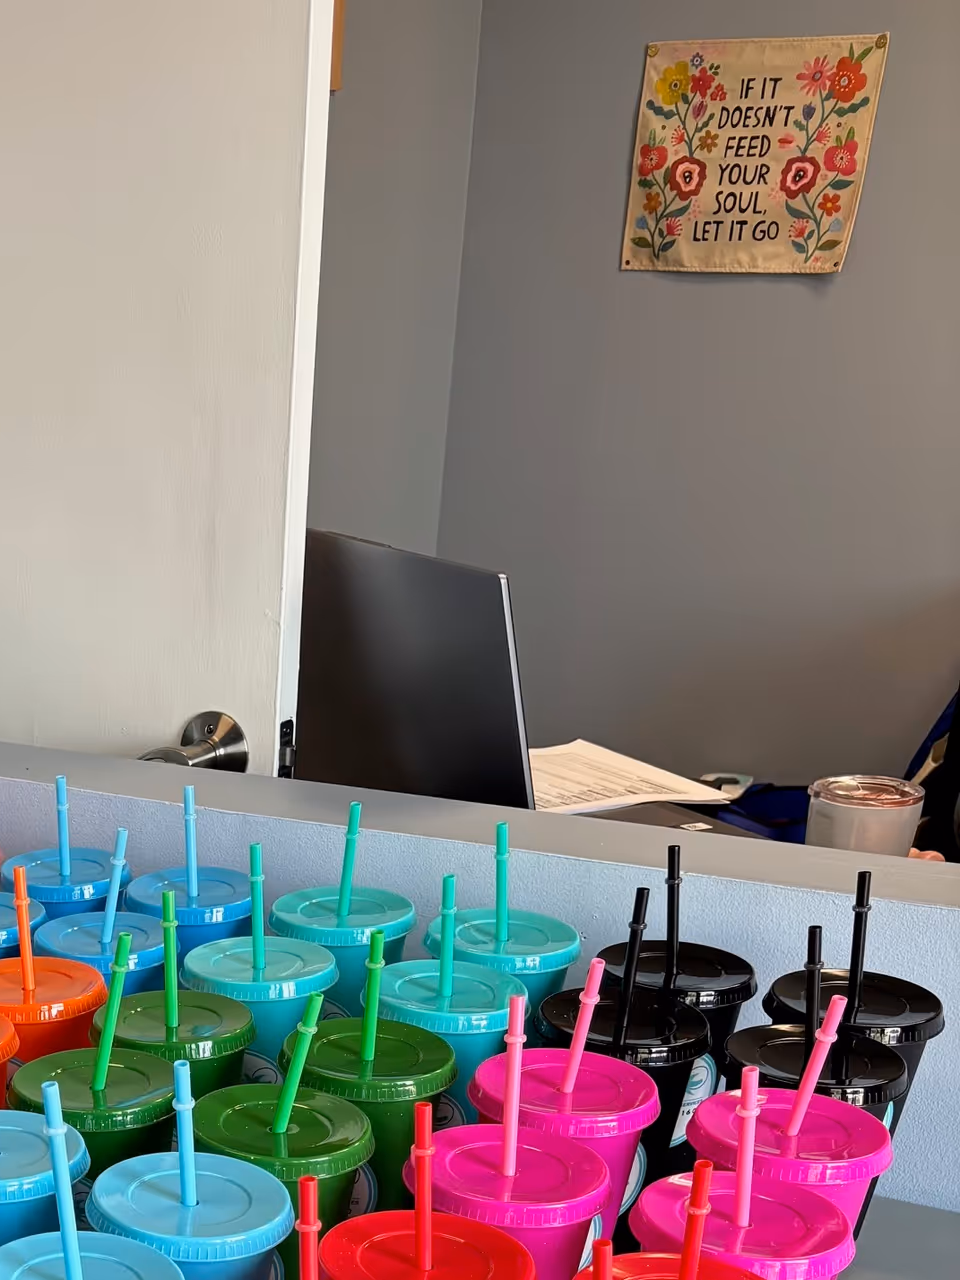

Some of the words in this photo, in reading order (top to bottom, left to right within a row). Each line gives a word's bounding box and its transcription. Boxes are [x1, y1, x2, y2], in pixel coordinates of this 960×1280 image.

[740, 78, 756, 99] IF
[761, 77, 782, 99] IT
[718, 105, 795, 129] DOESN'T
[724, 134, 771, 158] FEED
[718, 163, 770, 186] YOUR
[712, 190, 767, 215] SOUL,
[692, 220, 724, 242] LET
[728, 220, 748, 242] IT
[752, 220, 779, 241] GO
